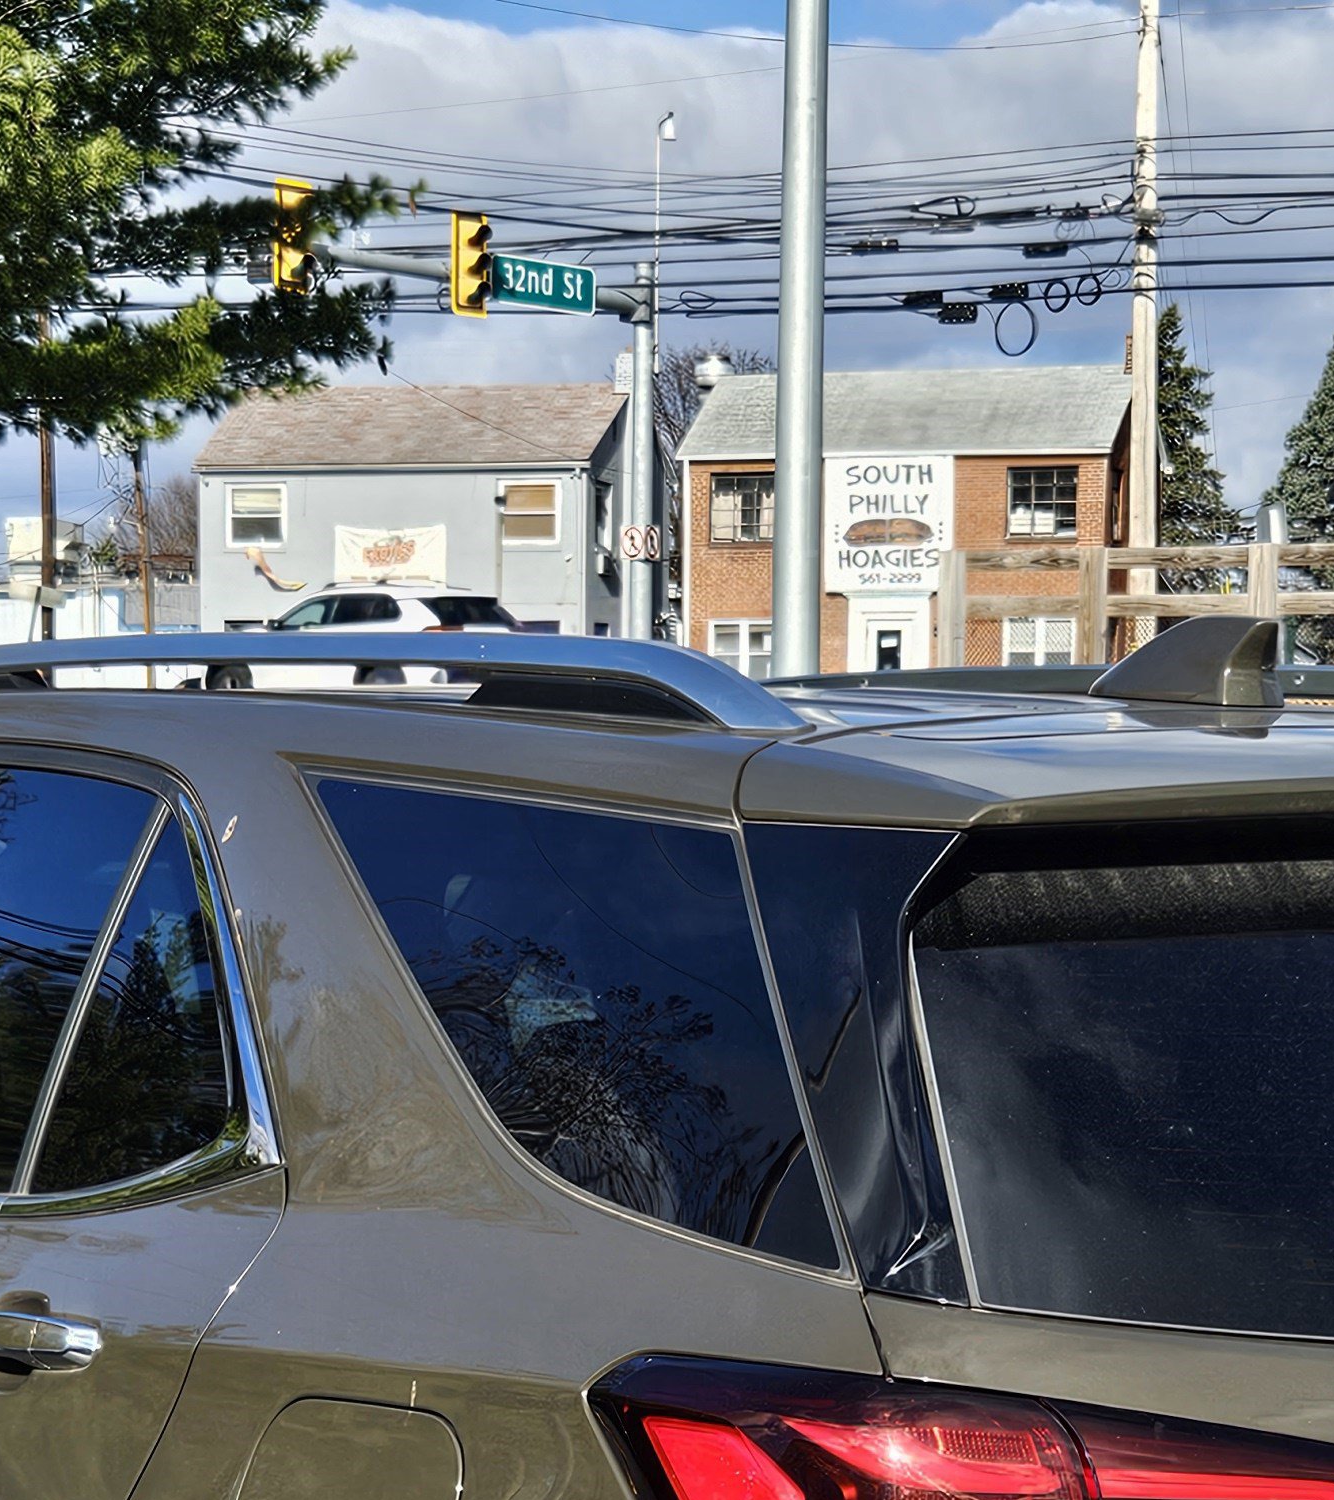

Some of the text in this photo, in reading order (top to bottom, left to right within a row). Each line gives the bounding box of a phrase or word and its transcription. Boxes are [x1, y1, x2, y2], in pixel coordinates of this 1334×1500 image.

[502, 262, 583, 301] 32nd St
[845, 463, 934, 487] SOUTH
[848, 493, 930, 515] PHILLY
[837, 547, 940, 570] HOAGIES
